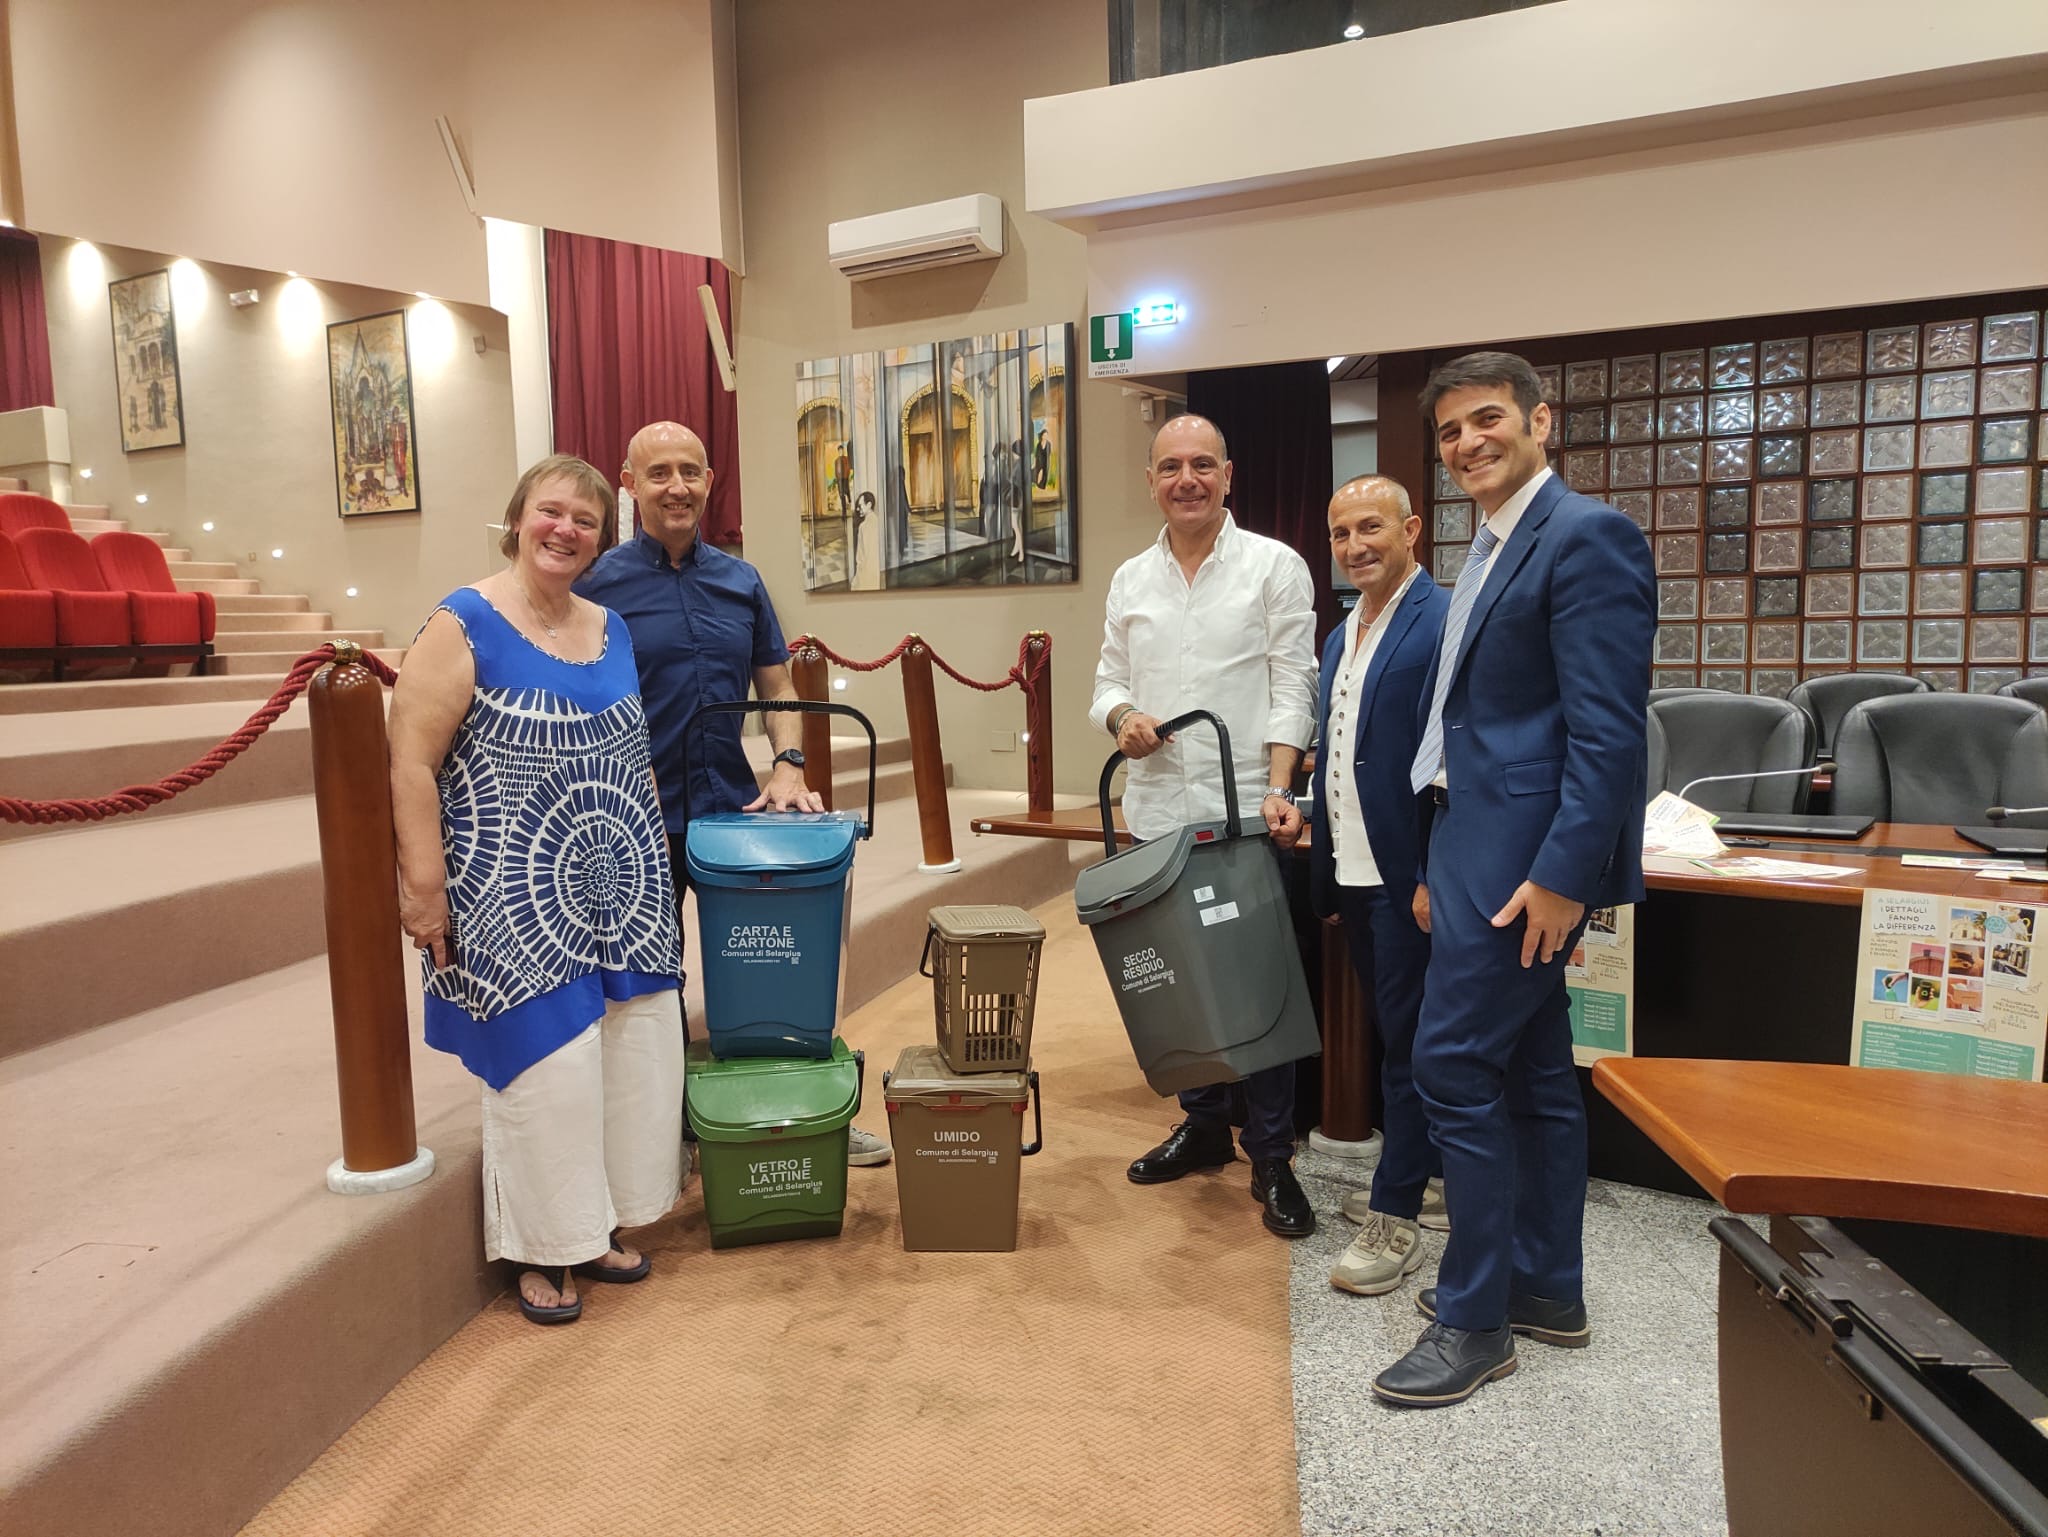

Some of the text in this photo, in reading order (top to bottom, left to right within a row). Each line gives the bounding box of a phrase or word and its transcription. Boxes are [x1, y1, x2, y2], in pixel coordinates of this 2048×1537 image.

[1888, 914, 1920, 922] FANNO
[731, 926, 792, 937] CARTA E
[1886, 923, 1936, 931] DIFFERENZA
[727, 937, 795, 948] CARTONE
[765, 950, 801, 958] Selargius
[1123, 947, 1156, 967] SECCO
[1122, 958, 1164, 981] RESIDUO
[1121, 979, 1143, 991] Comune
[1143, 976, 1150, 984] di
[1149, 969, 1174, 982] Selargius
[933, 1131, 980, 1142] UMIDO
[961, 1149, 999, 1157] Selargius
[748, 1157, 812, 1174] VETRO E
[751, 1169, 811, 1185] LATTINE
[739, 1186, 774, 1195] Comune
[785, 1180, 823, 1190] Selargius
